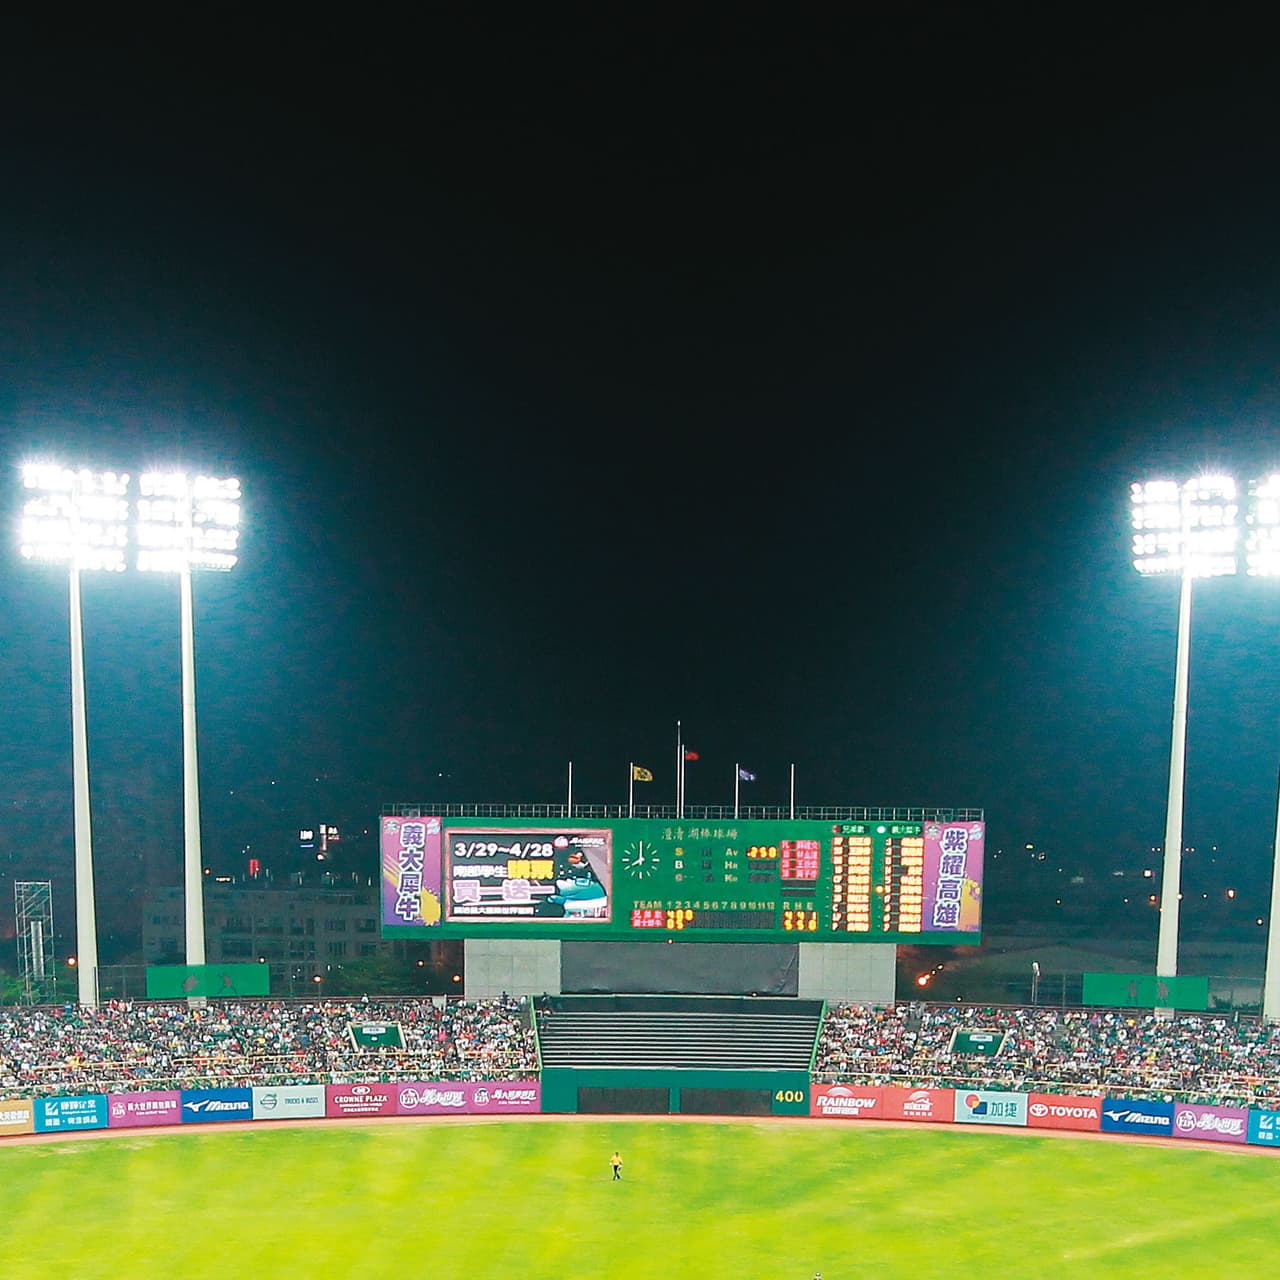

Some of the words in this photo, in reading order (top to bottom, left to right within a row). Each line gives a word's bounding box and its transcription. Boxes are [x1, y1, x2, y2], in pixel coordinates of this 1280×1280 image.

[454, 842, 554, 858] 3/29~4/28
[396, 822, 427, 921] 義大犀牛
[674, 861, 683, 869] B
[933, 828, 969, 928] 紫耀高雄
[452, 879, 556, 903] 買一送一
[633, 901, 662, 909] TEAM
[334, 1096, 364, 1104] CROWNE
[365, 1095, 388, 1103] PLAZA
[775, 1090, 804, 1103] 400
[816, 1096, 877, 1108] RAINBOW
[990, 1102, 1018, 1118] 加捷
[1049, 1105, 1098, 1119] TOYOTA
